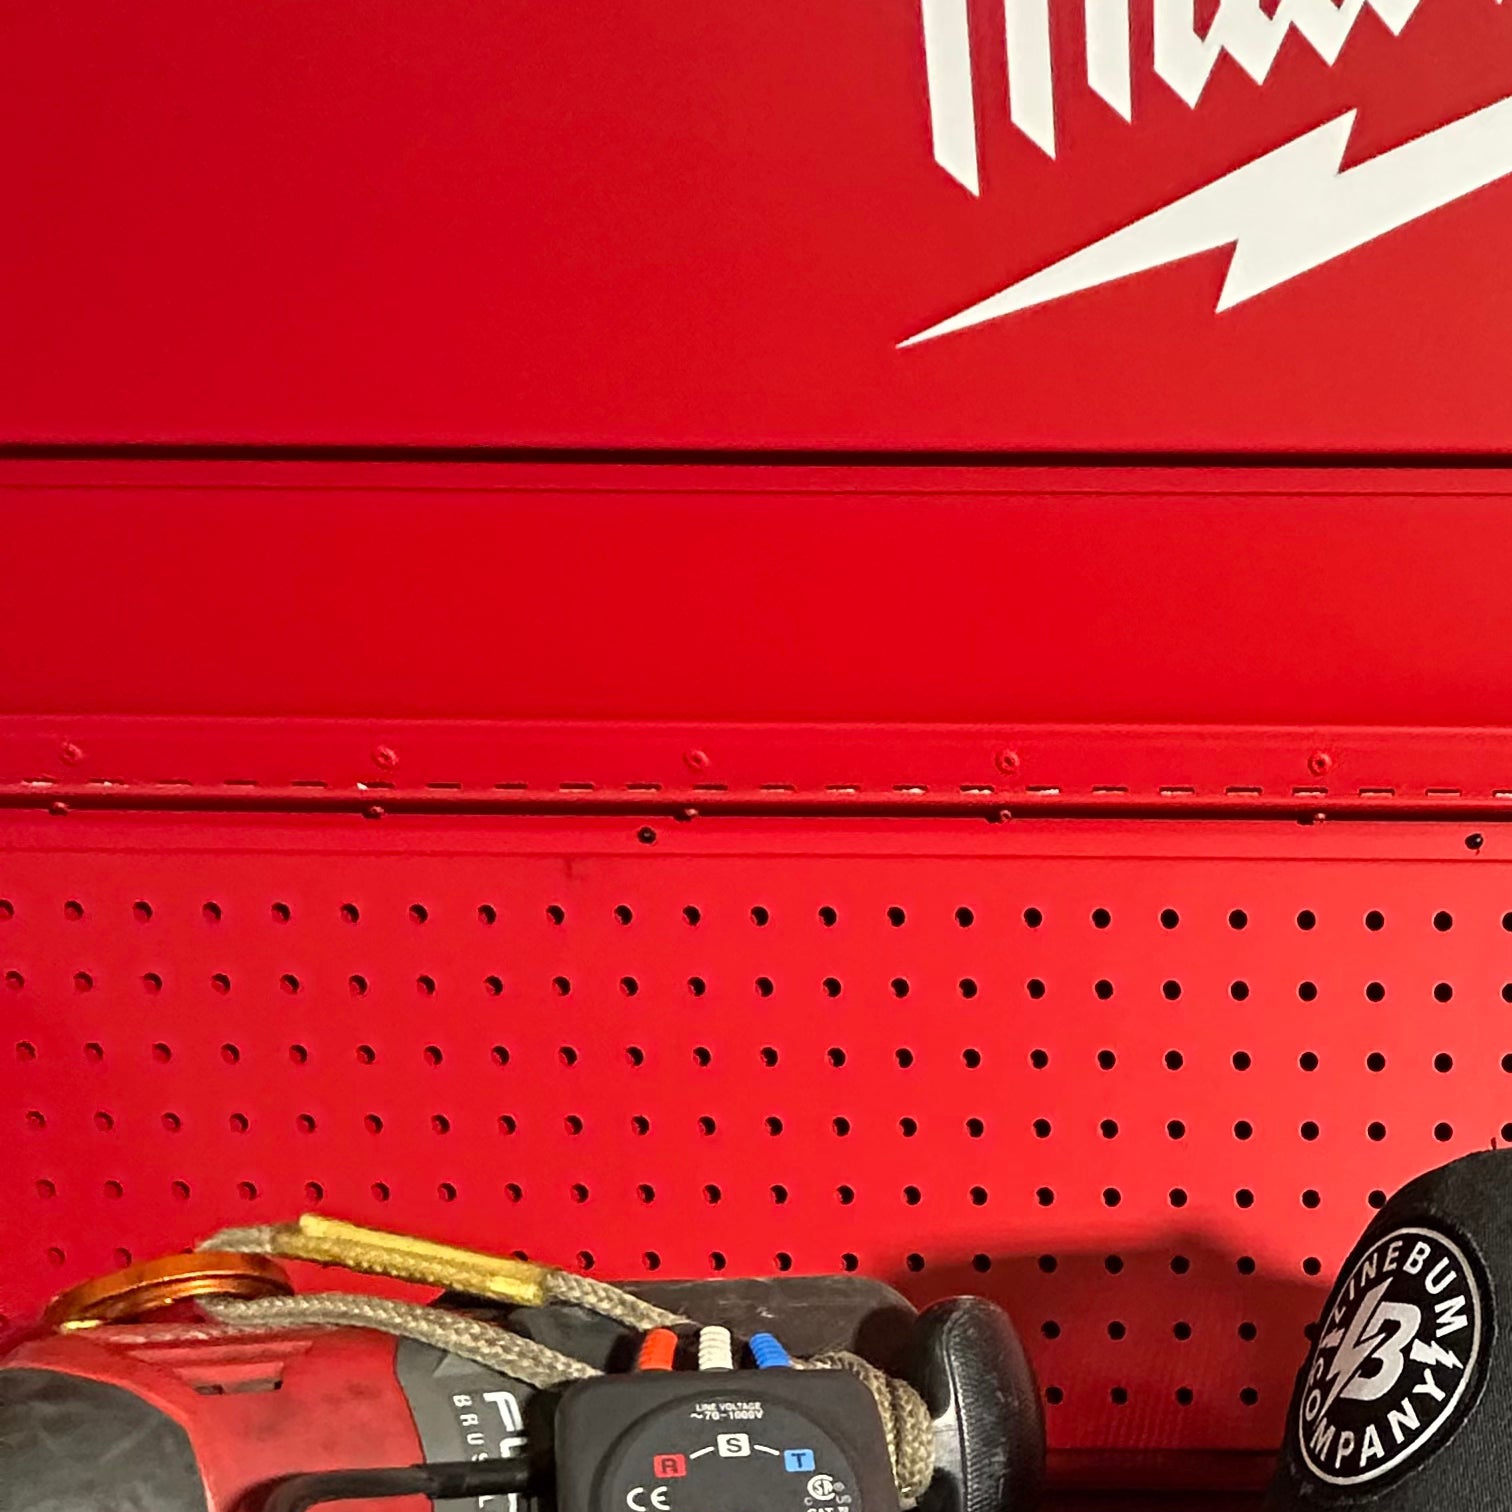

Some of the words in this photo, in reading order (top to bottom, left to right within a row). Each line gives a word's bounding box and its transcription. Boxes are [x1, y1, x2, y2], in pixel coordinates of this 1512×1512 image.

[718, 1401, 762, 1411] VOLTAGE
[725, 1437, 743, 1454] S
[661, 1458, 679, 1475] R
[790, 1452, 807, 1470] T
[626, 1485, 671, 1512] CE
